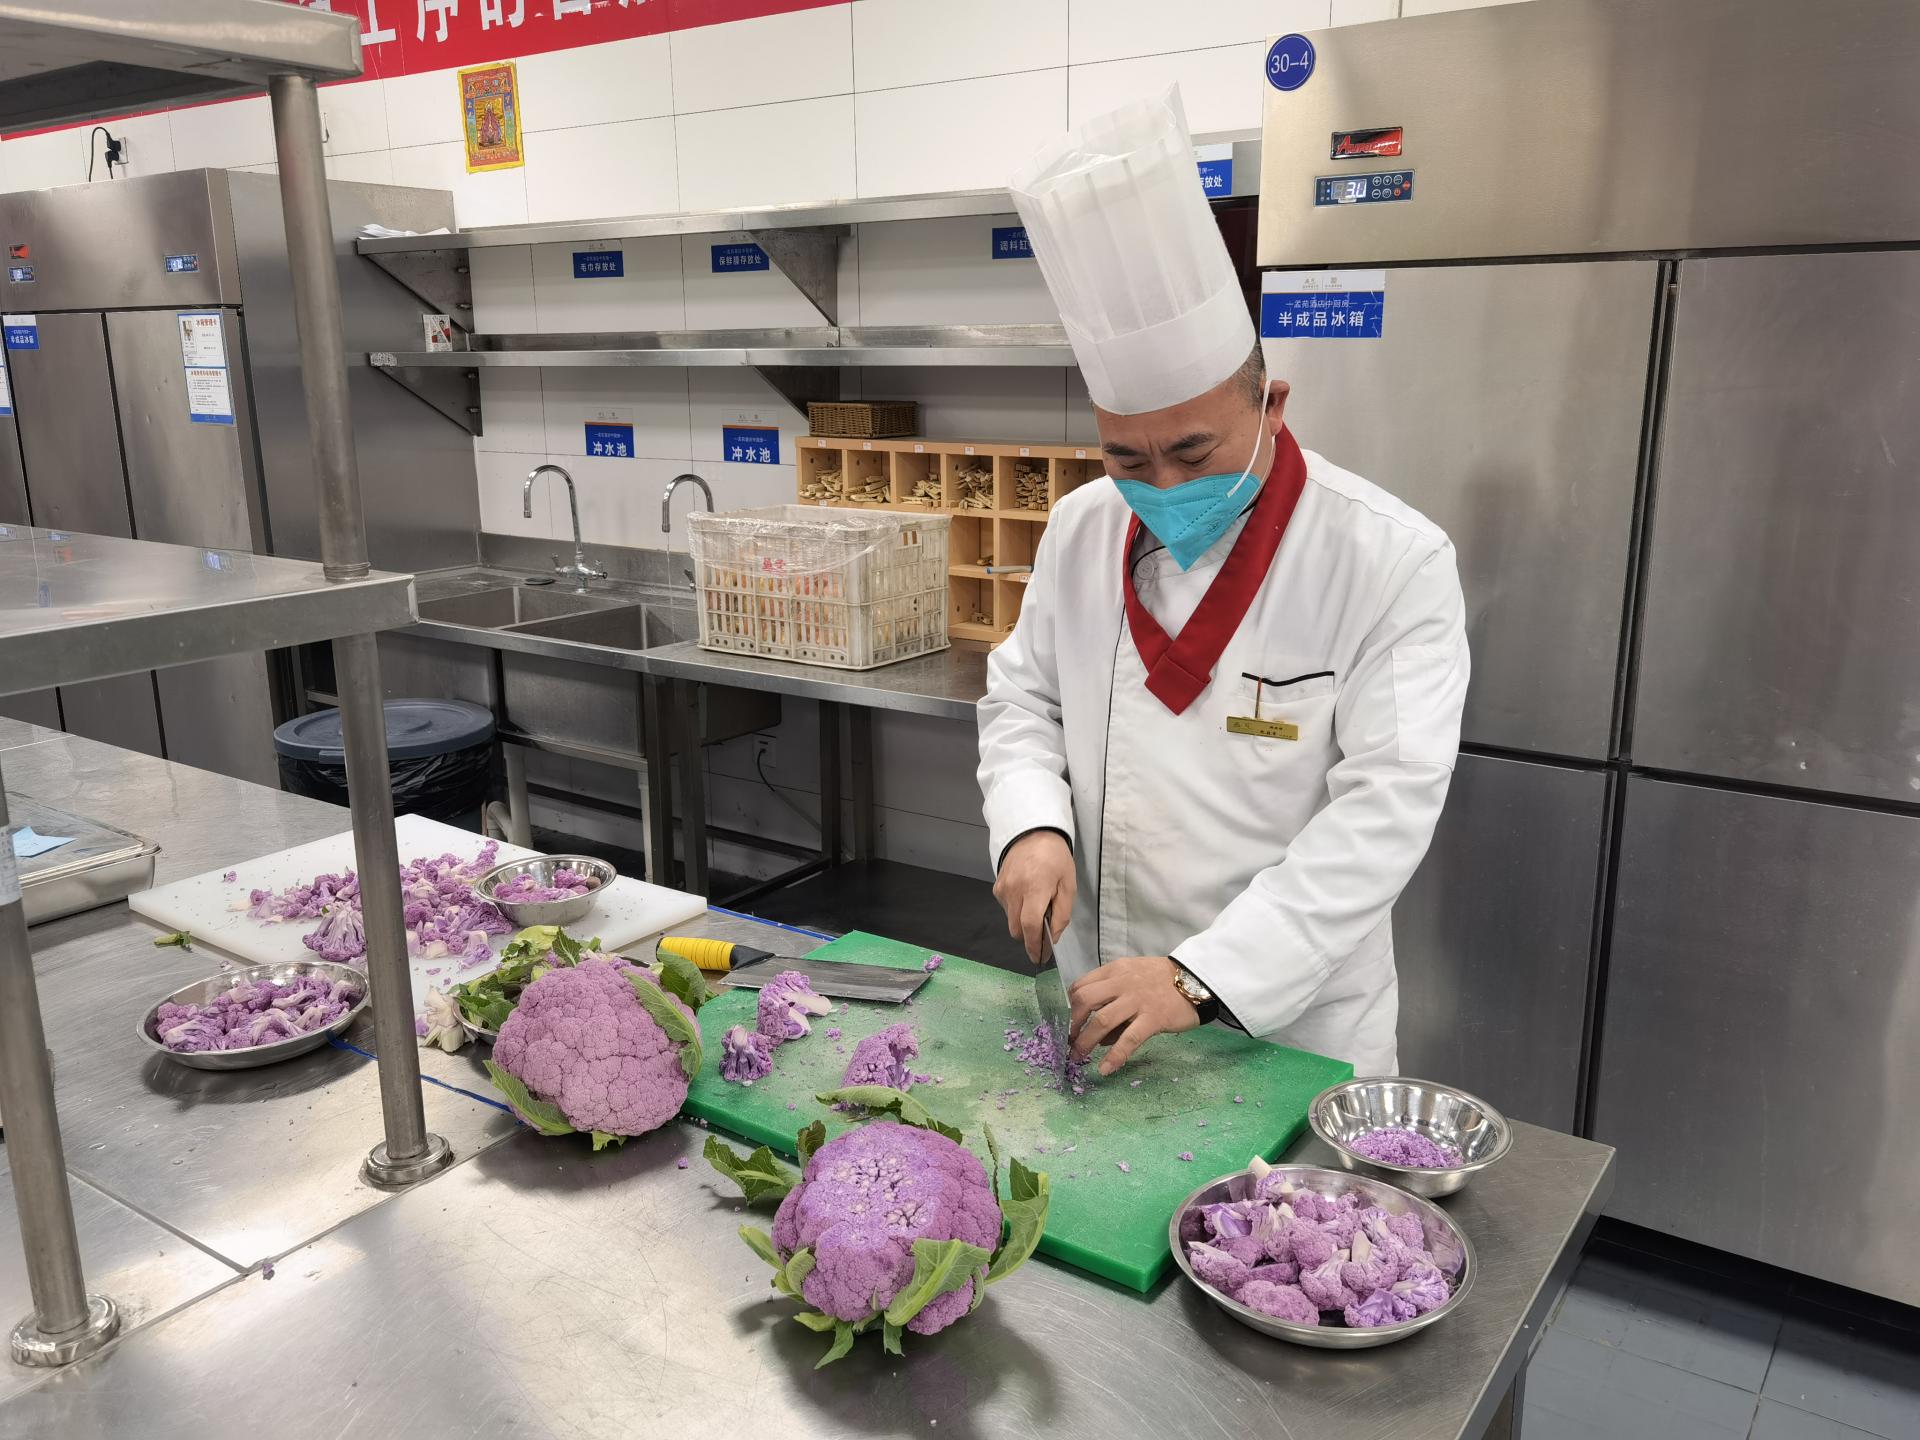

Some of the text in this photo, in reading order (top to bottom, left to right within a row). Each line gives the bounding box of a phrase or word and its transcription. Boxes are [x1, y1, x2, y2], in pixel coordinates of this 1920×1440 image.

[1271, 50, 1309, 73] 30-4
[580, 262, 617, 272] 毛巾存放处
[1278, 311, 1364, 327] 半成品冰箱
[593, 441, 627, 457] 冲水池
[732, 446, 771, 463] 冲水池
